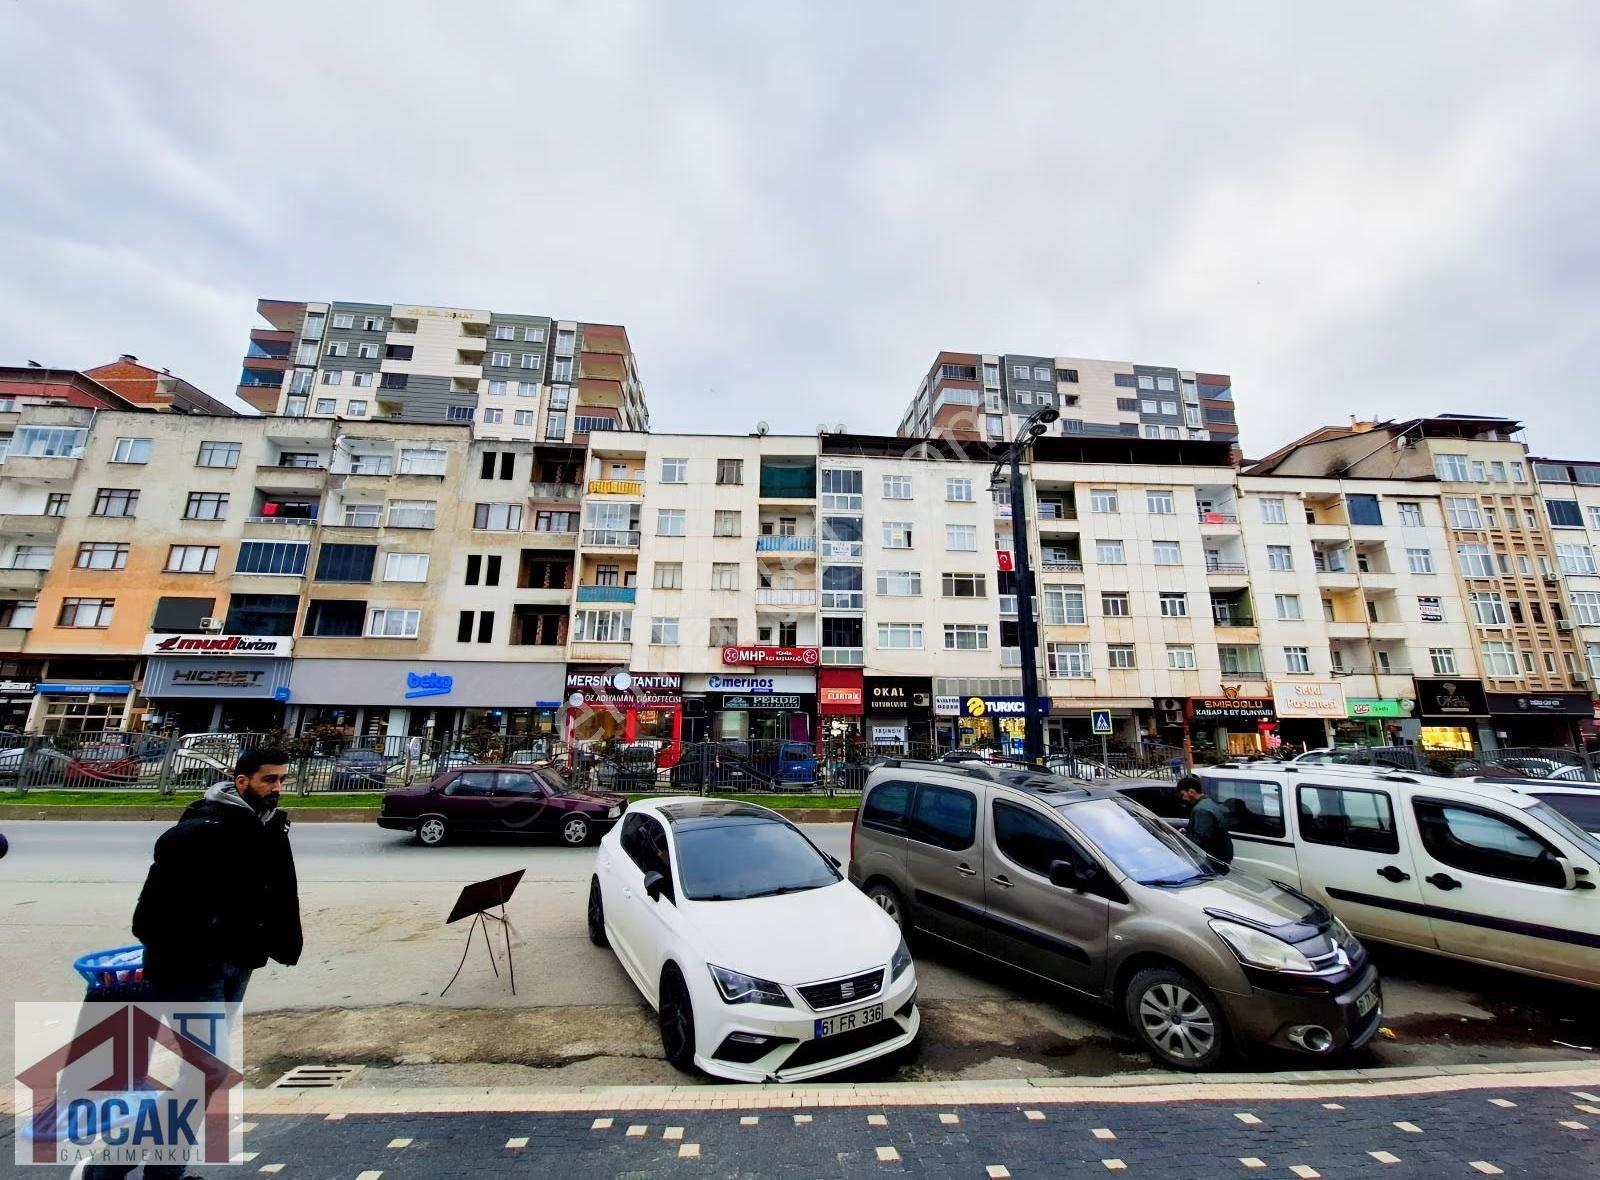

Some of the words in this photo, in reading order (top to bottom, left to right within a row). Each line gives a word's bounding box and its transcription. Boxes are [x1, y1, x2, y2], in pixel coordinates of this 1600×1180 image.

[739, 651, 766, 661] MHP
[408, 672, 453, 688] beko
[722, 678, 774, 688] merinos
[873, 687, 905, 697] OKAL
[822, 1020, 834, 1036] 61
[840, 1014, 856, 1032] FR
[863, 1006, 882, 1024] 336
